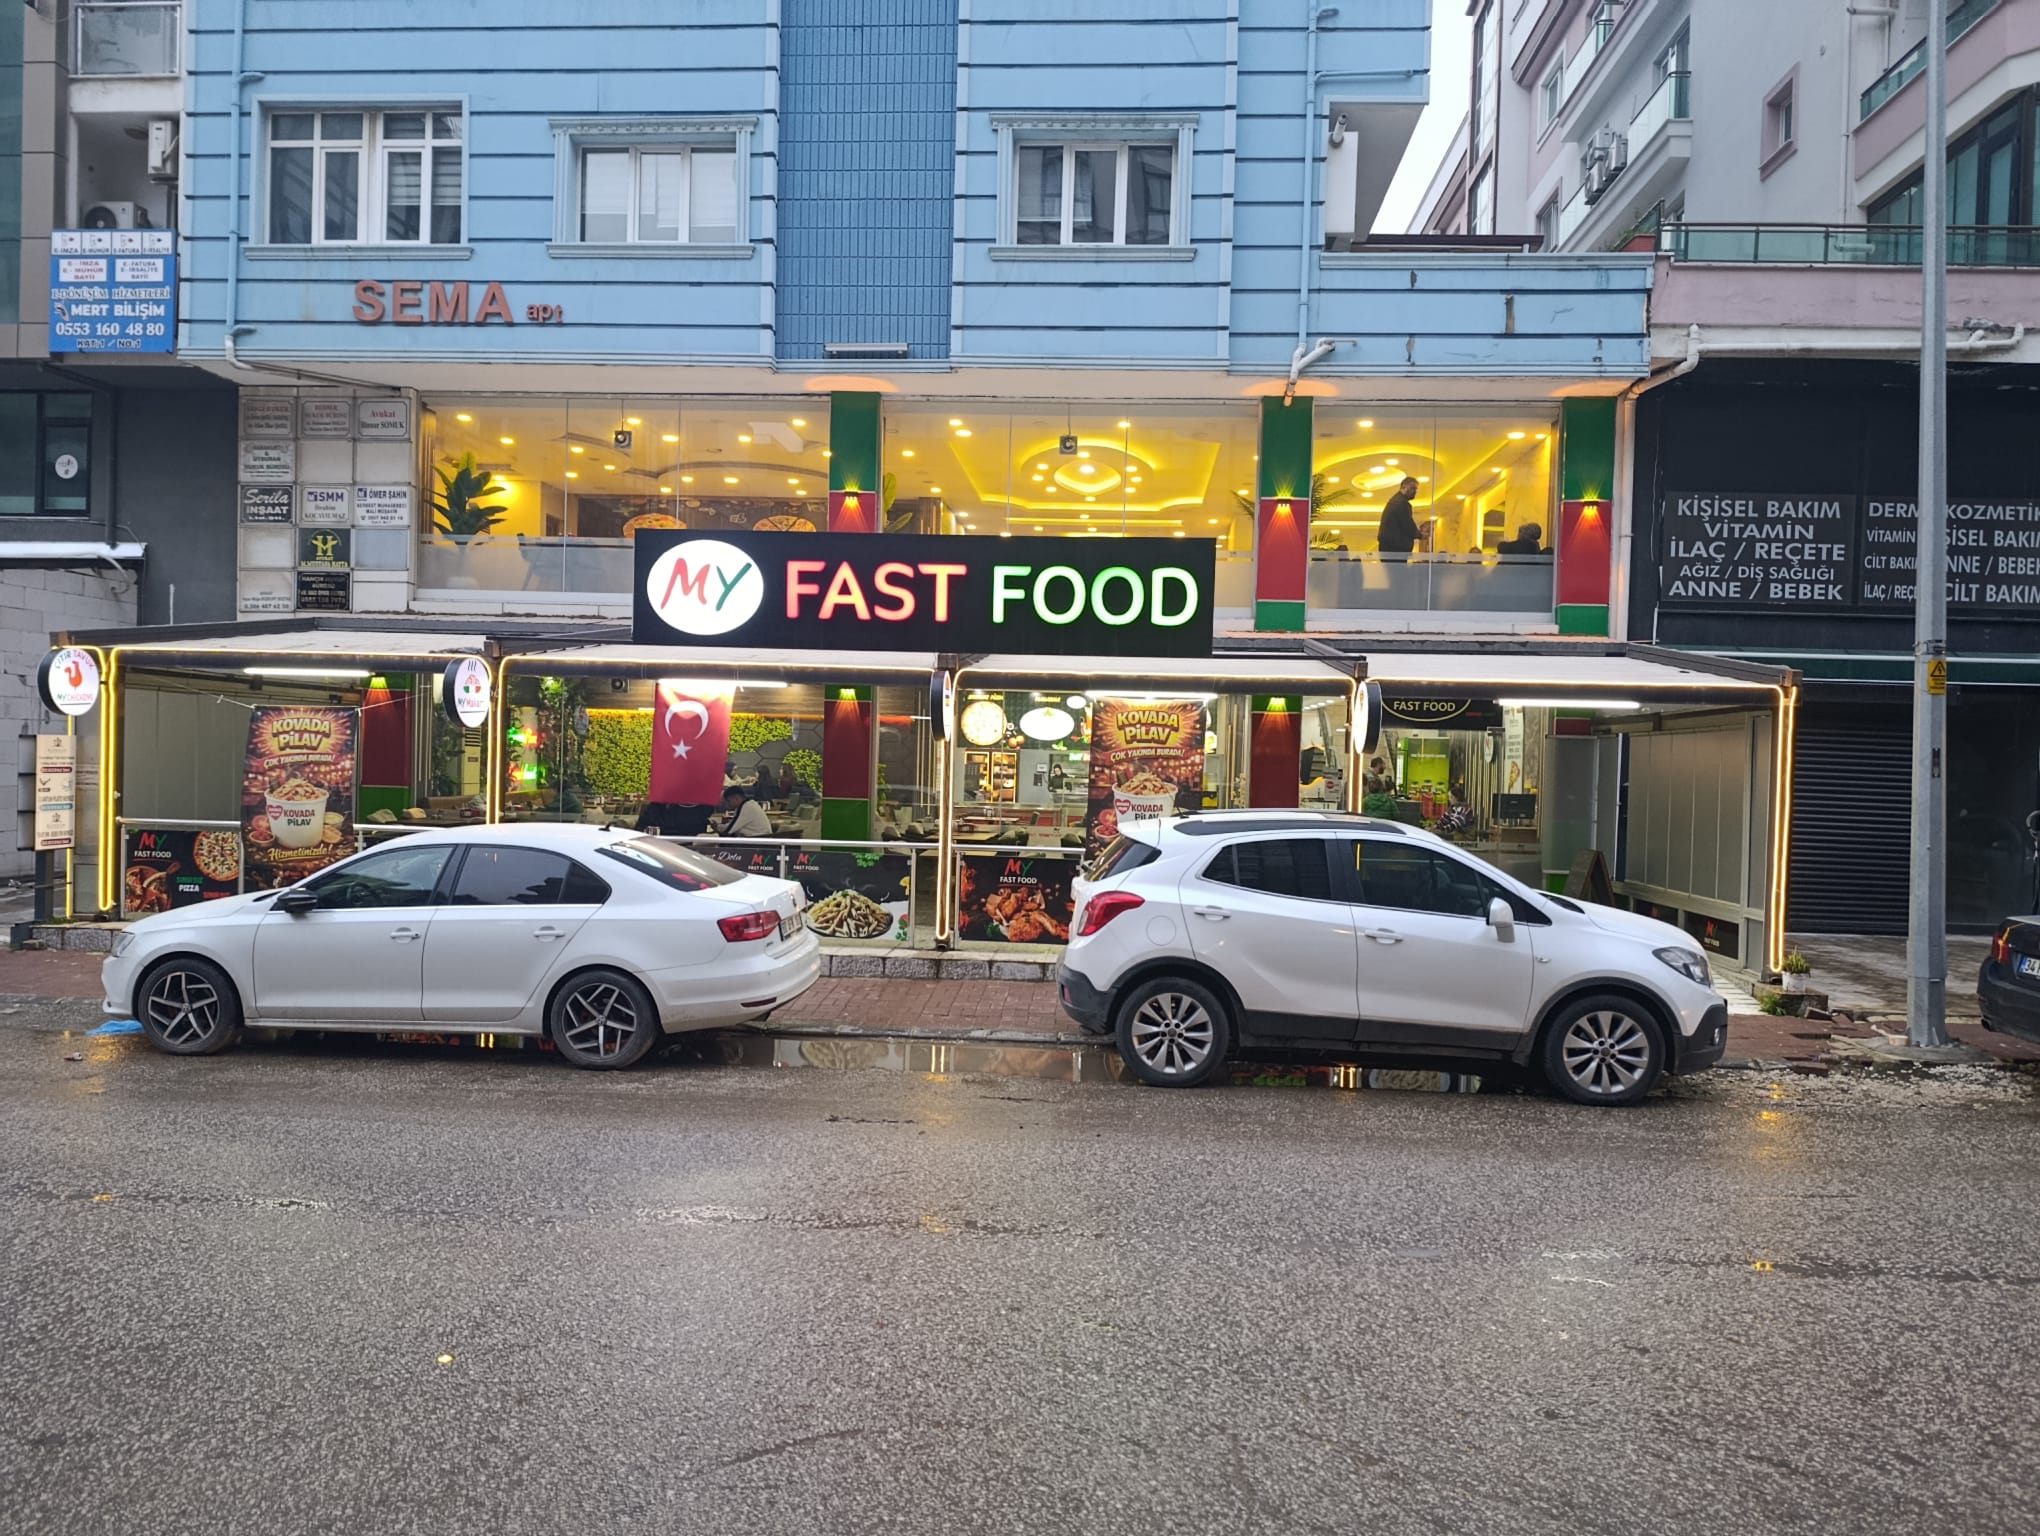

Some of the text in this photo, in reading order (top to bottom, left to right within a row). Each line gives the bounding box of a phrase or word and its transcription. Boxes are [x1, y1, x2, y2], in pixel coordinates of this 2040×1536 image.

[70, 301, 165, 320] MERT BİLİŞİM
[352, 279, 564, 327] SEMA apt
[56, 322, 165, 336] 0553 160 48 80
[1677, 494, 1841, 521] KİŞİSEL BAKIM
[1704, 519, 1815, 540] VİTAMİN
[1866, 526, 1916, 543] VİTAMİN
[1670, 536, 1726, 563] İLAÇ
[1755, 542, 1846, 567] REÇETE
[1864, 553, 1887, 569] CİLT
[1679, 562, 1720, 577] AĞIZ
[1738, 563, 1764, 581] DİŞ
[1769, 564, 1835, 581] SAĞLIĞI
[660, 557, 1199, 626] MY FAST FOOD
[1668, 580, 1742, 598] ANNE
[1769, 583, 1844, 600] BEBEK
[1864, 581, 1886, 602] İLAÇ
[1393, 701, 1456, 712] FAST FOOD
[271, 718, 331, 736] KOVADA
[1116, 710, 1179, 728] KOVADA
[1110, 752, 1128, 762] ÇOK
[283, 809, 315, 818] KOVADA
[1131, 804, 1163, 813] KOVADA
[139, 832, 168, 851] MY
[134, 850, 151, 858] FAST
[267, 844, 333, 861] Hizmetinizde!
[751, 853, 770, 865] MY
[796, 853, 817, 865] MY
[1004, 858, 1034, 876] MY
[1017, 876, 1038, 884] FOOD
